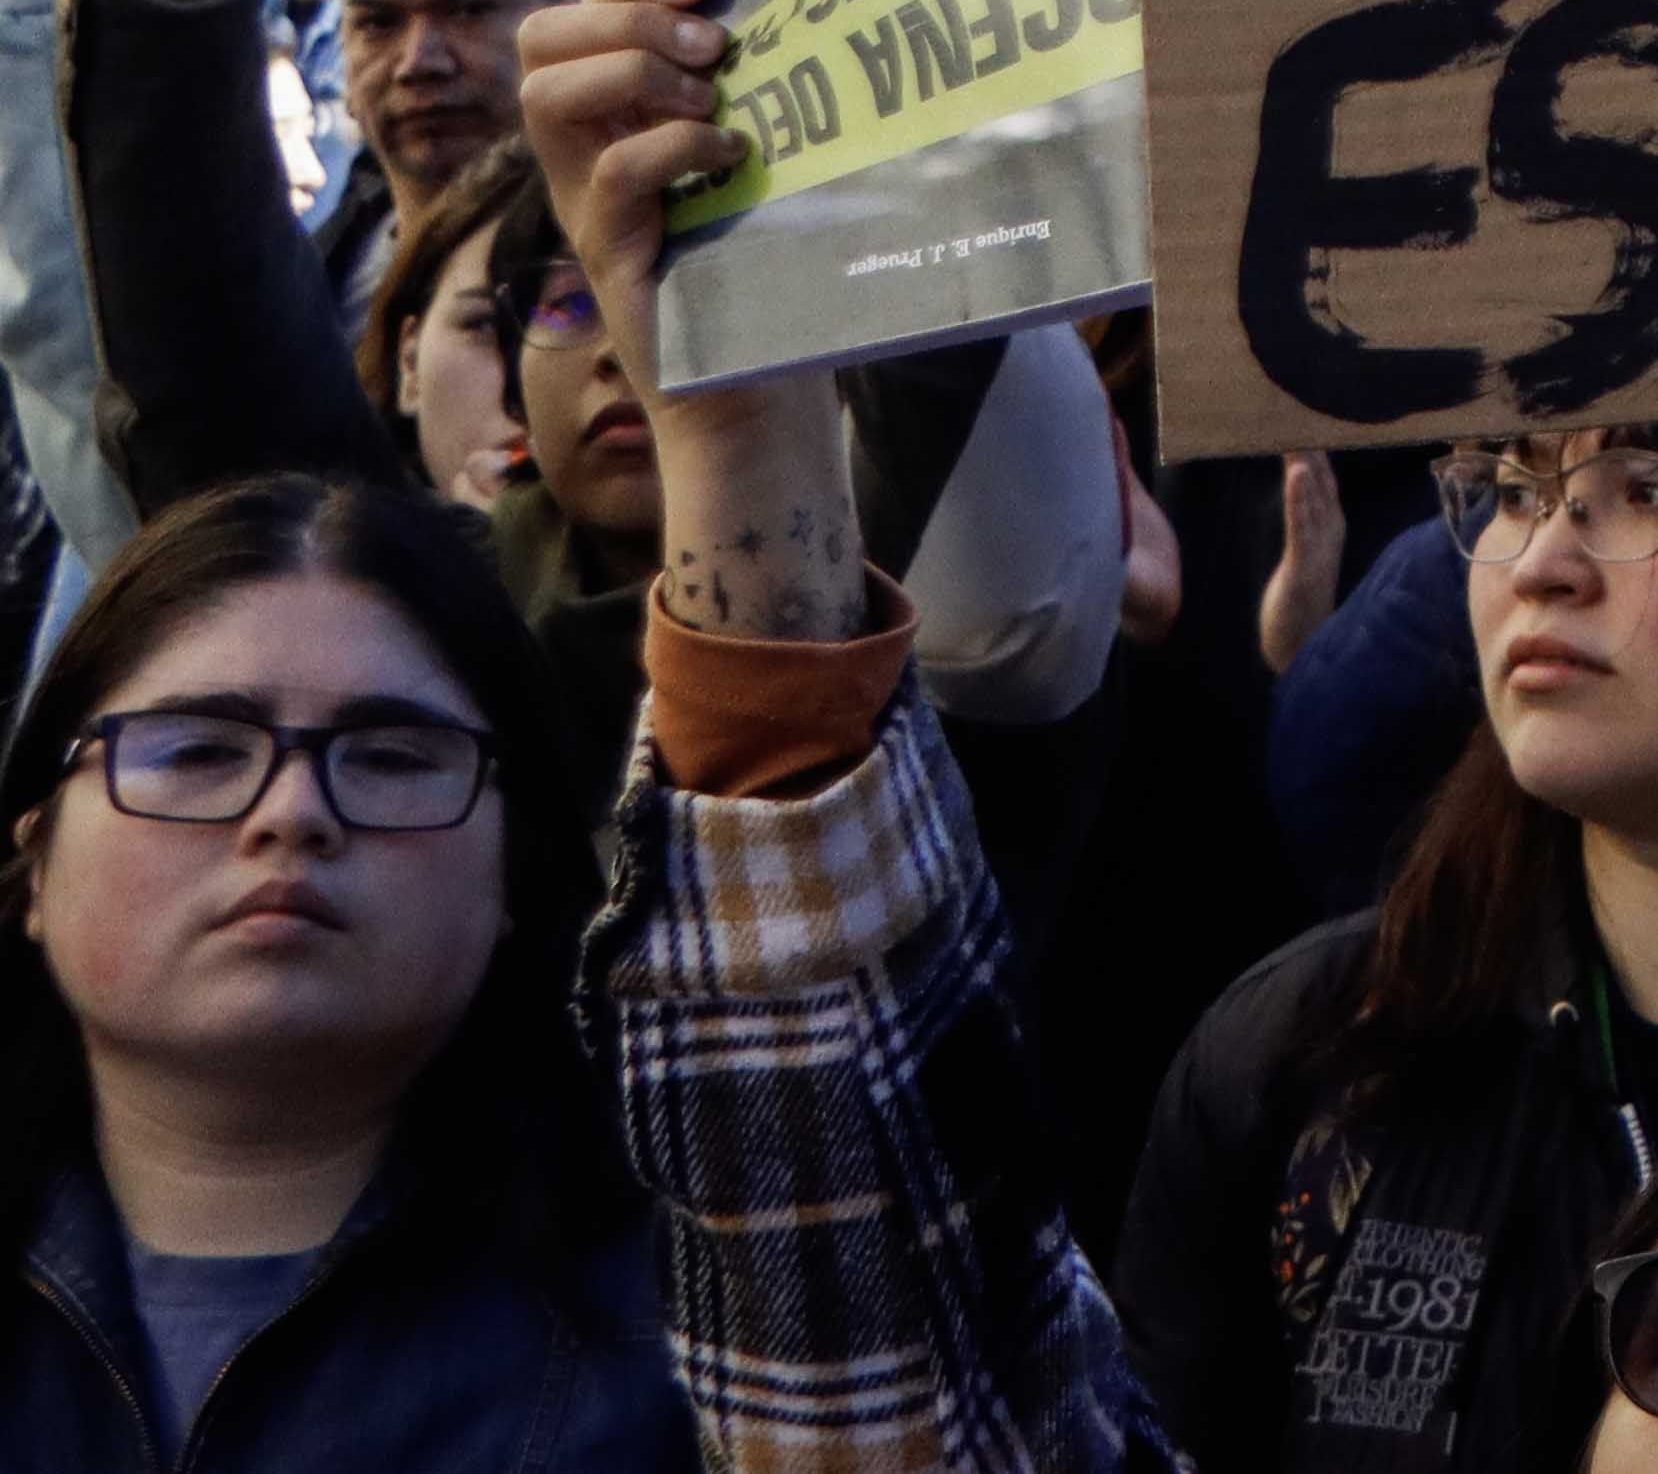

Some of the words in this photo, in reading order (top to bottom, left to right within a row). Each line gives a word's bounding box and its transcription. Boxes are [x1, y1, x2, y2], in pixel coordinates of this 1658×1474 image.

[729, 54, 842, 169] DEL
[976, 219, 1052, 251] Enrique
[846, 249, 924, 279] Prueger
